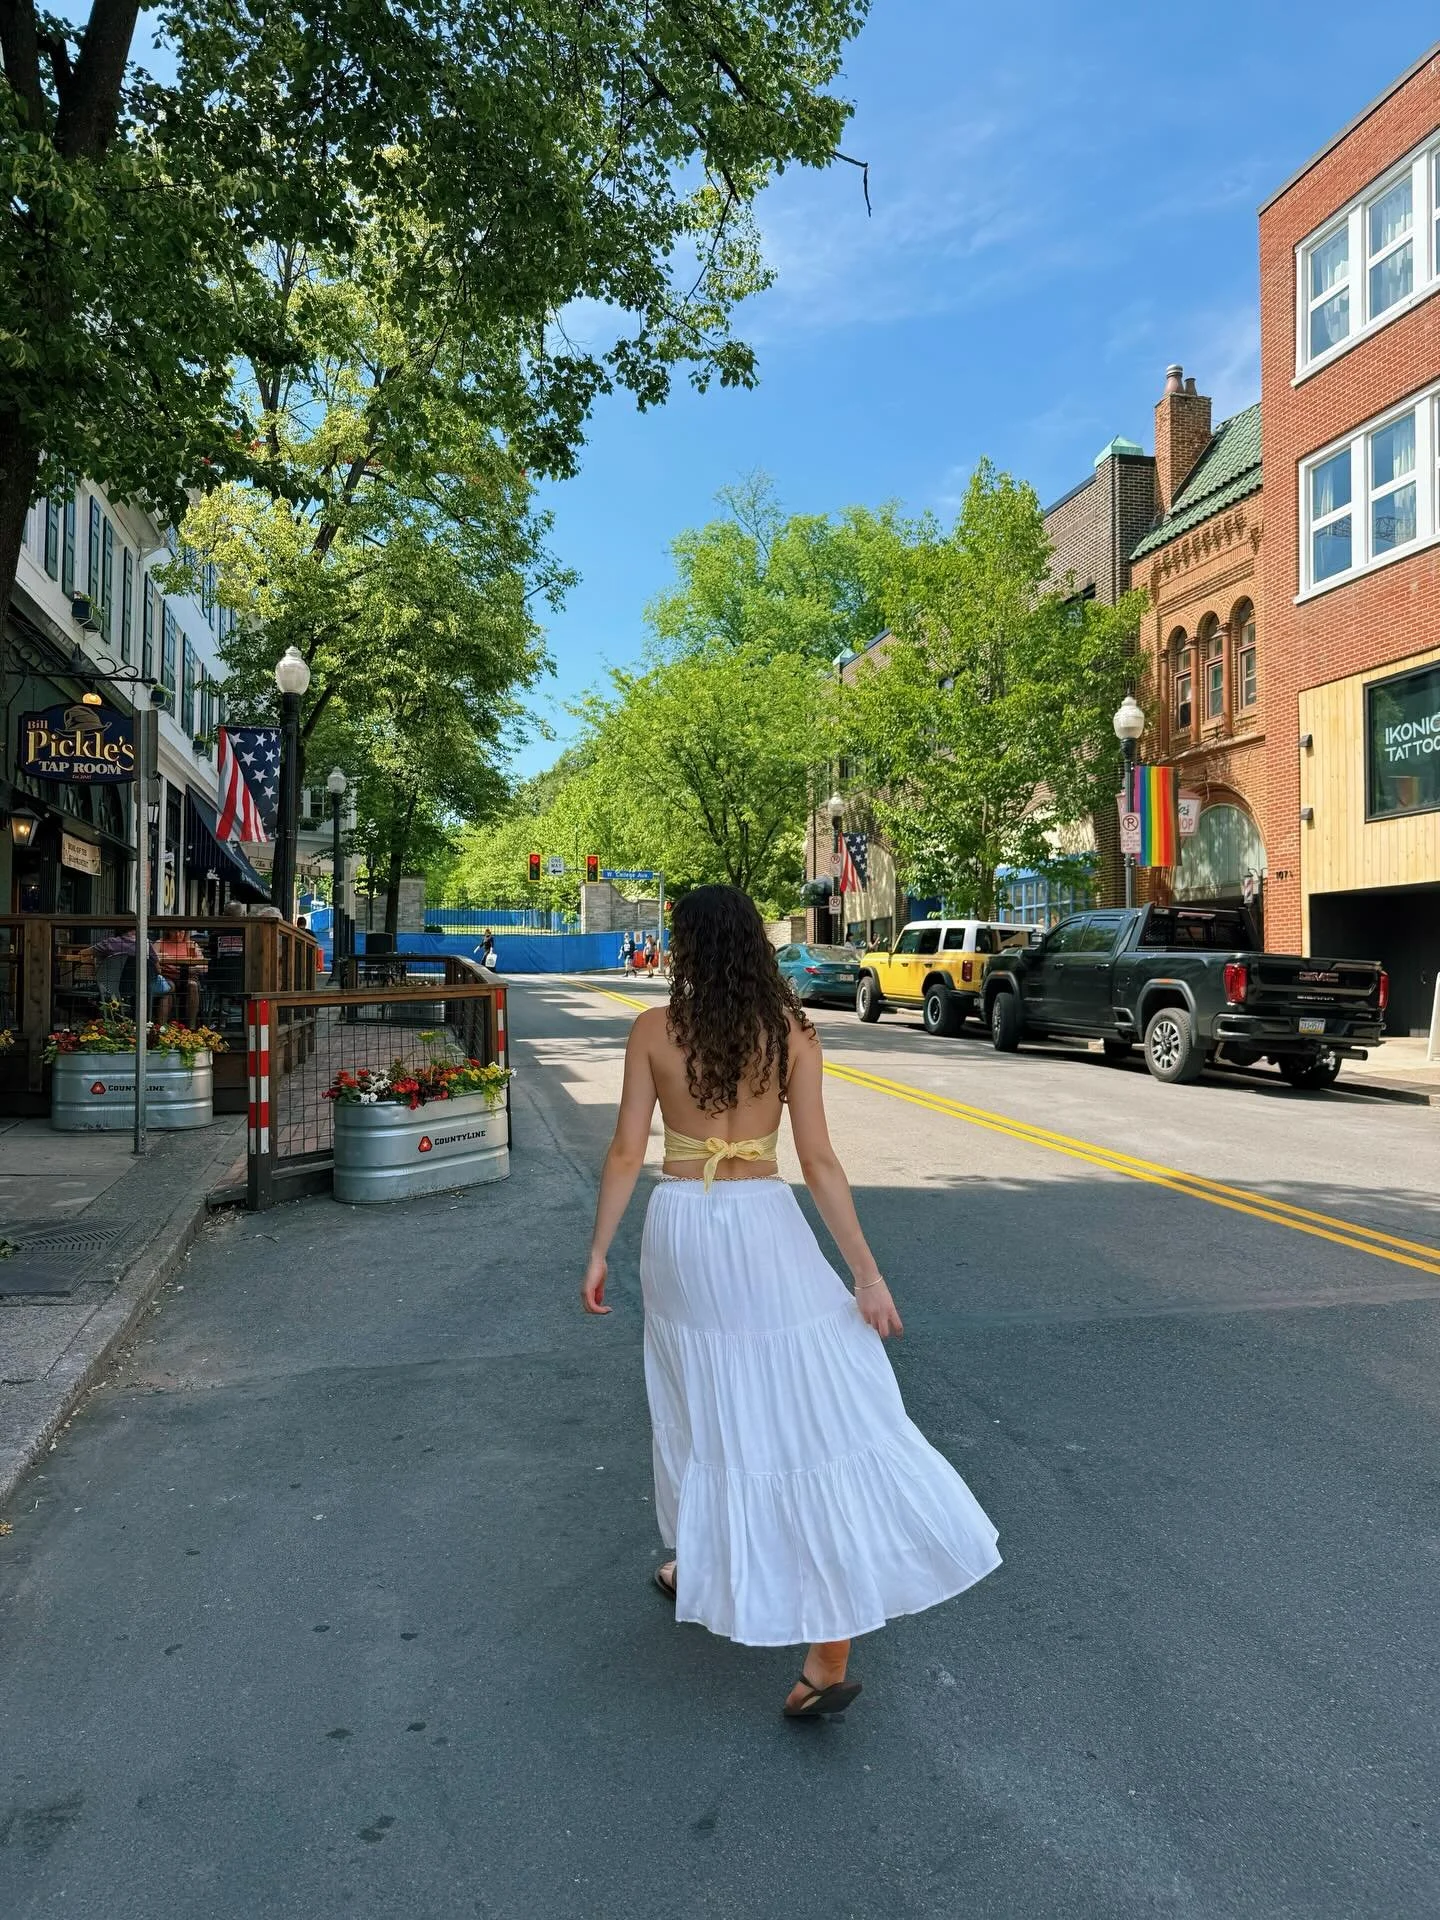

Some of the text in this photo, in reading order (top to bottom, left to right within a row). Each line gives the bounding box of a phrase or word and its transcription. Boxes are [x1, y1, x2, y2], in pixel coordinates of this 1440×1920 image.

[27, 720, 48, 729] Bill
[1385, 714, 1440, 745] IKONIC
[25, 730, 135, 771] Pickle's
[1384, 735, 1440, 762] TATTOO
[38, 760, 122, 775] TAP ROOM
